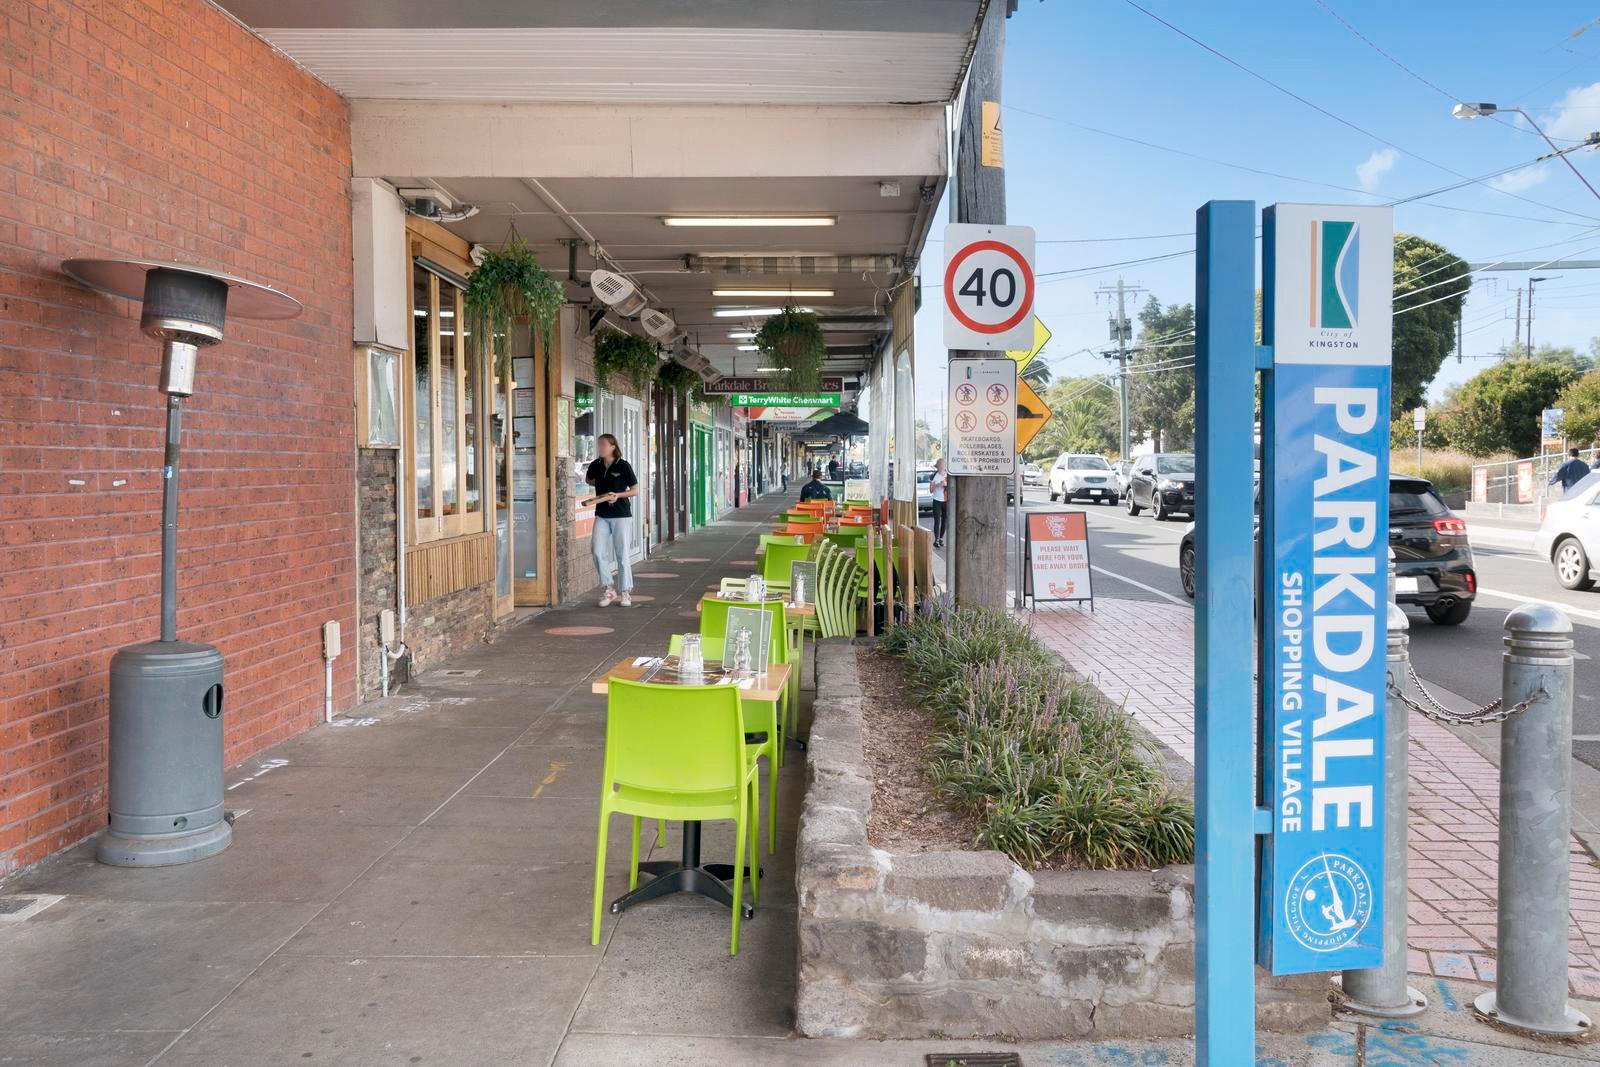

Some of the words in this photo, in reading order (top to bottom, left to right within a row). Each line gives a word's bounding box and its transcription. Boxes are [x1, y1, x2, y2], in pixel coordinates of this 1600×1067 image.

[959, 268, 1016, 307] 40
[749, 396, 791, 404] TerryWhite
[792, 396, 833, 404] Chemmart
[1312, 388, 1378, 832] PARKDALE
[1282, 571, 1302, 711] SHOPPING
[1282, 720, 1302, 832] VILLAGE
[1291, 886, 1302, 931] VILLAGE
[1333, 860, 1366, 916] PARKDALE
